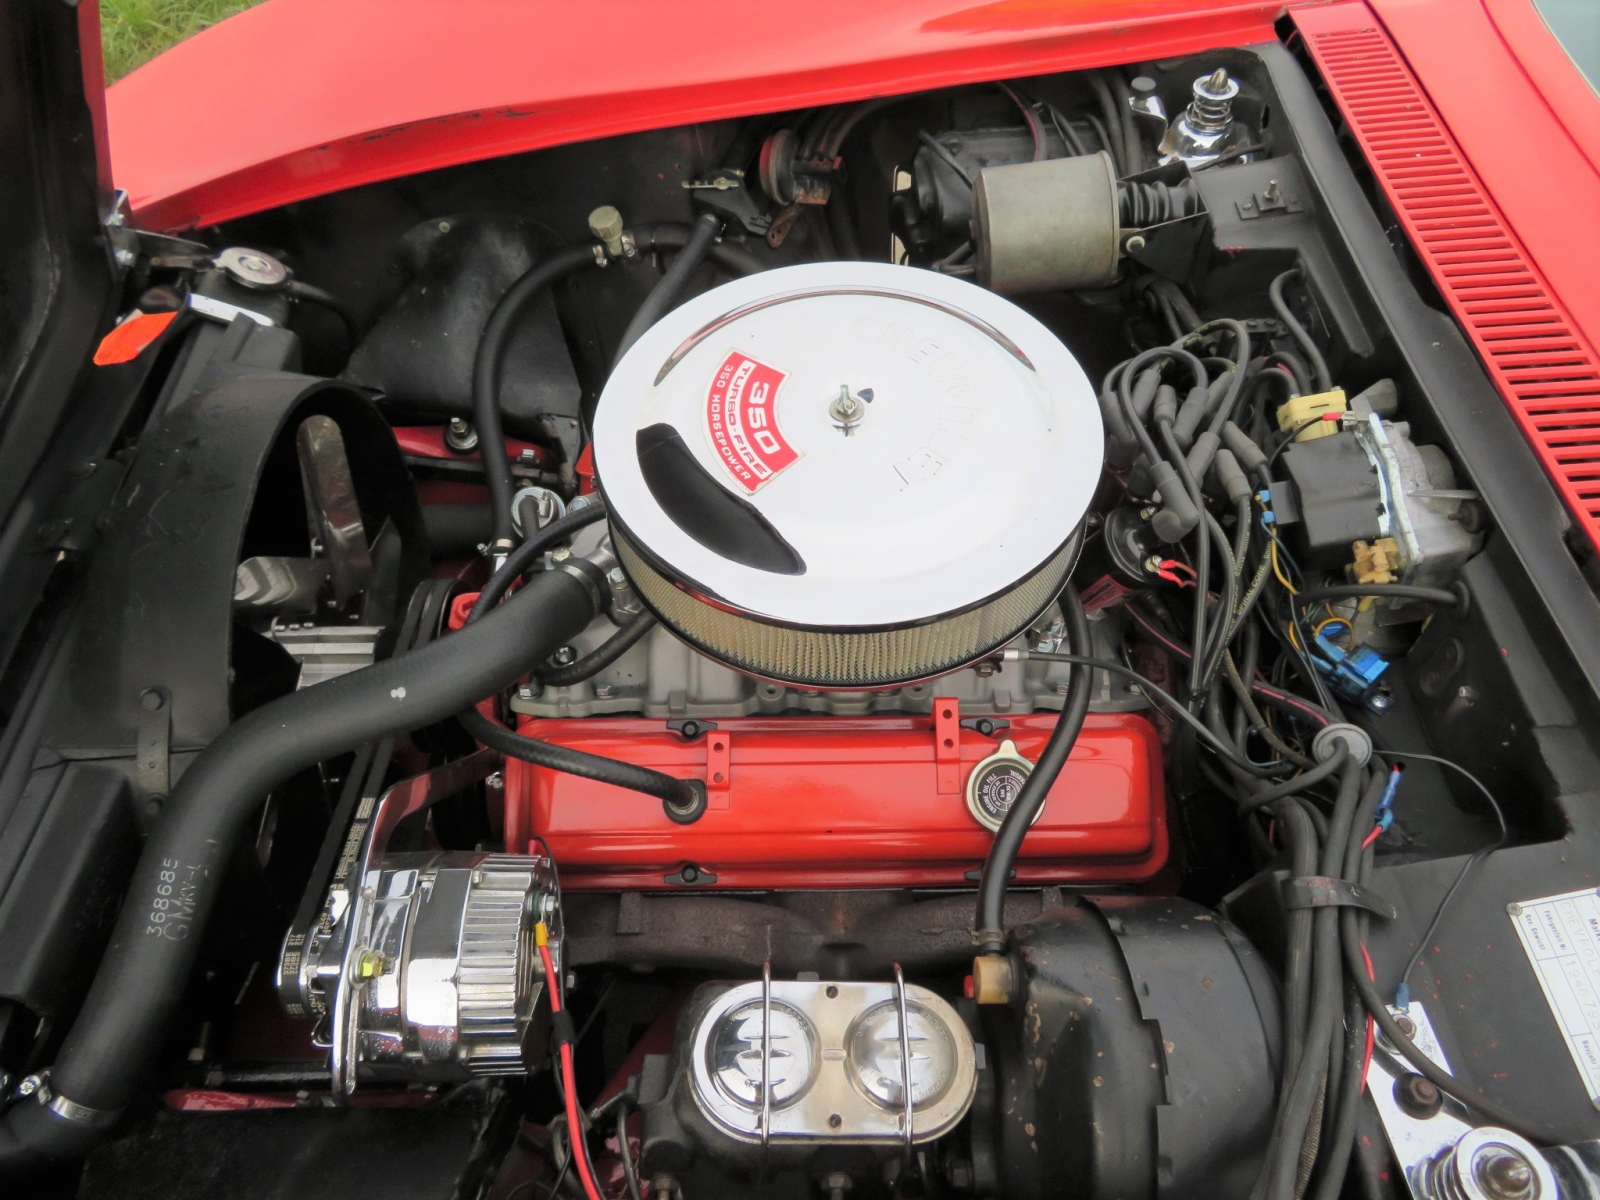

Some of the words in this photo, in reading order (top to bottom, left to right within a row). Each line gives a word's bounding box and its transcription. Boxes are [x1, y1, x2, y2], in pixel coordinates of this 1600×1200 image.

[716, 364, 734, 389] 350
[710, 394, 752, 480] HORSEPOWER
[727, 365, 769, 476] TURBO-FIRE
[747, 381, 781, 455] 350
[1249, 563, 1266, 588] CORE
[986, 773, 998, 784] FILL
[1010, 769, 1026, 785] ANUAL
[145, 857, 179, 937] 368685
